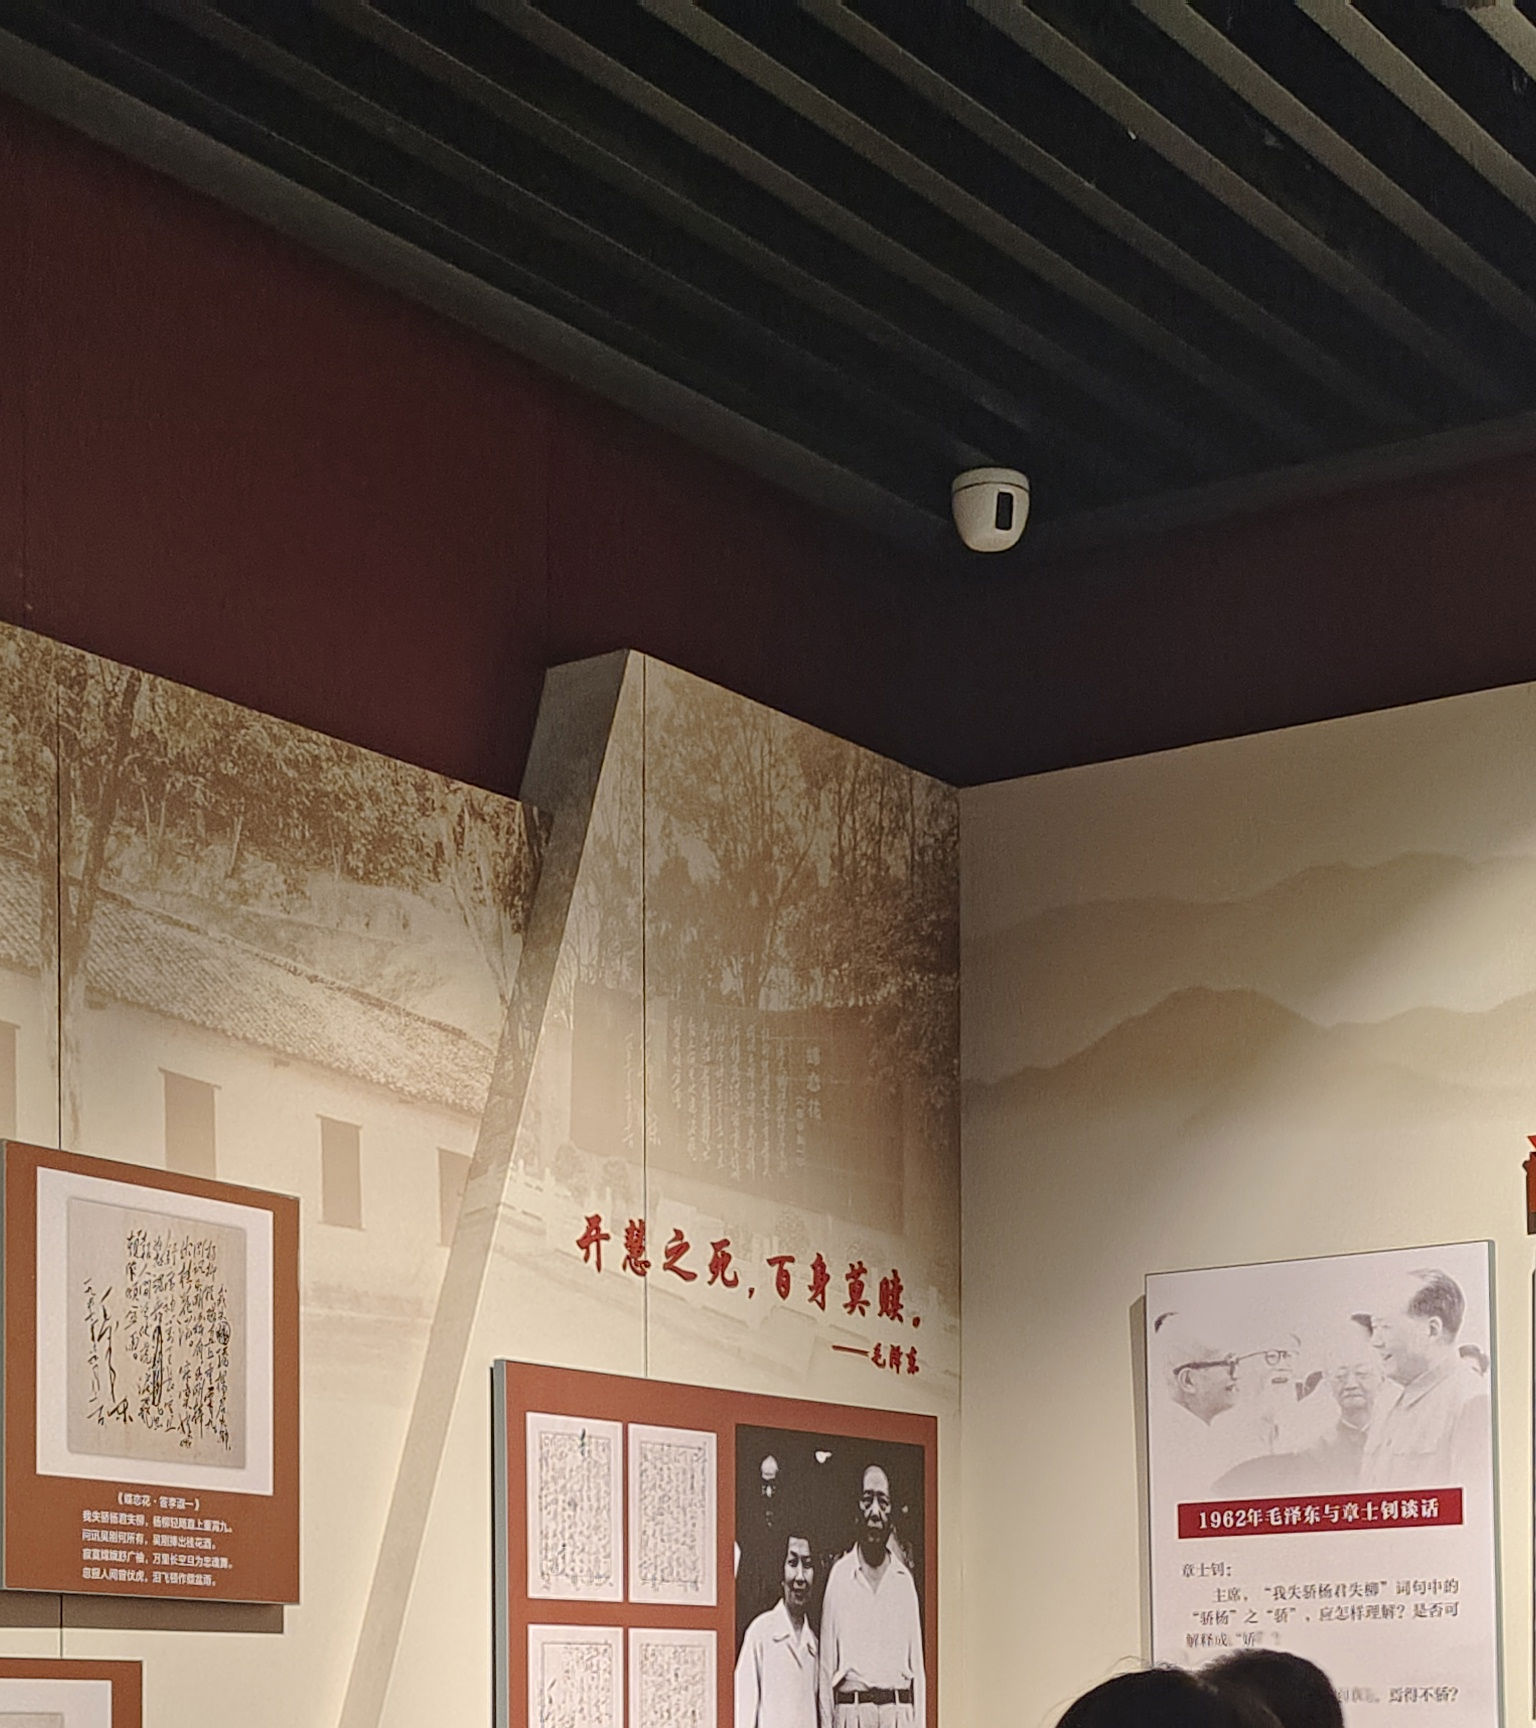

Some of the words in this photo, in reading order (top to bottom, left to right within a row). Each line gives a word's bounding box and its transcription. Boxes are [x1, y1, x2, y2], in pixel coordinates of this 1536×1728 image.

[1198, 1497, 1440, 1530] 1962年毛泽东与章士钊谈话
